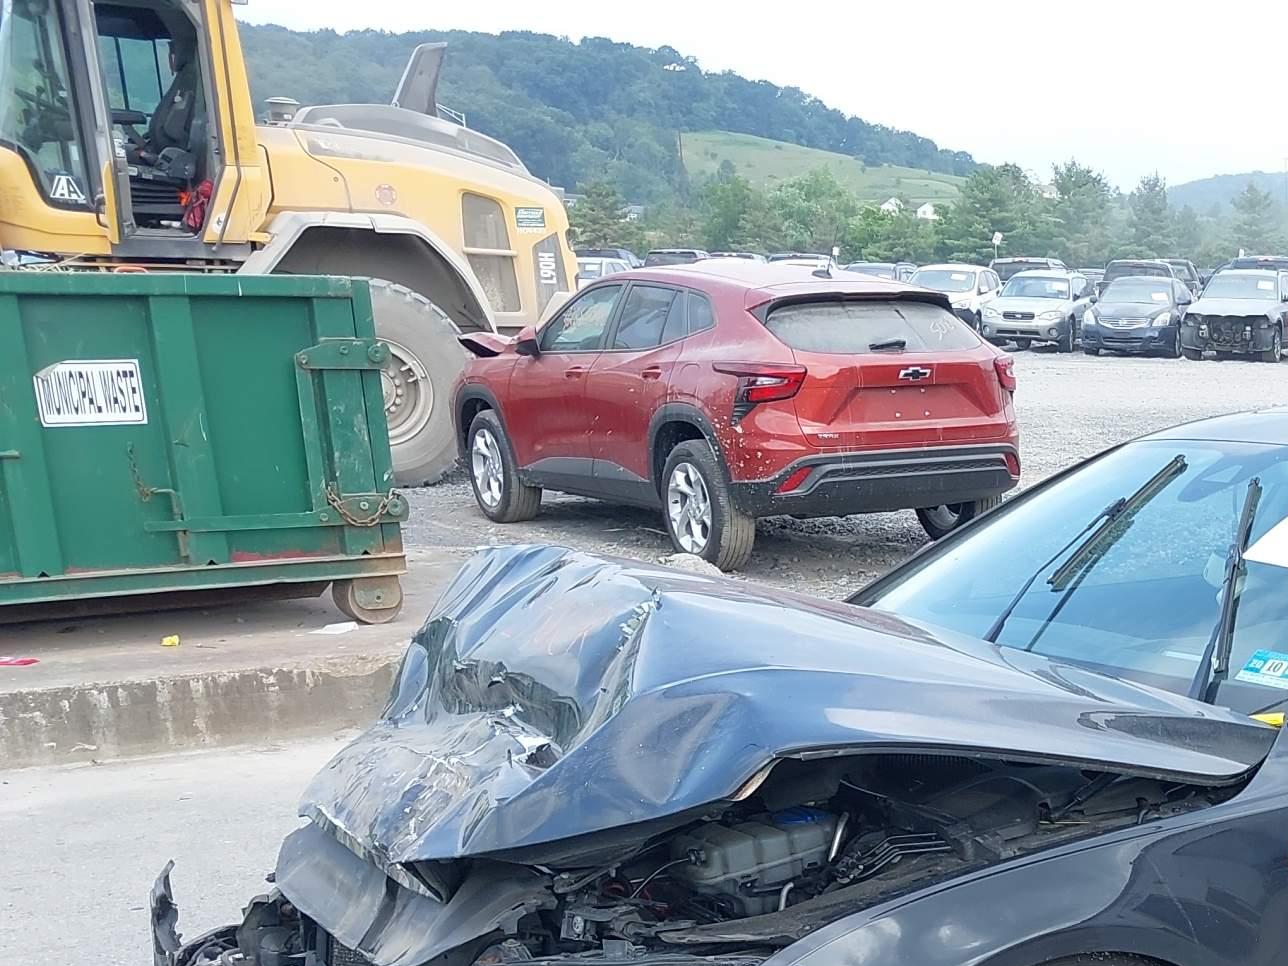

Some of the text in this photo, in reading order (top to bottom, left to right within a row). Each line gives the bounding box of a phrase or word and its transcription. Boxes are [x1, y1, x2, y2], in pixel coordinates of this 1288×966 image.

[41, 369, 140, 416] MUNICIPAL WASTE
[1266, 661, 1284, 673] 10
